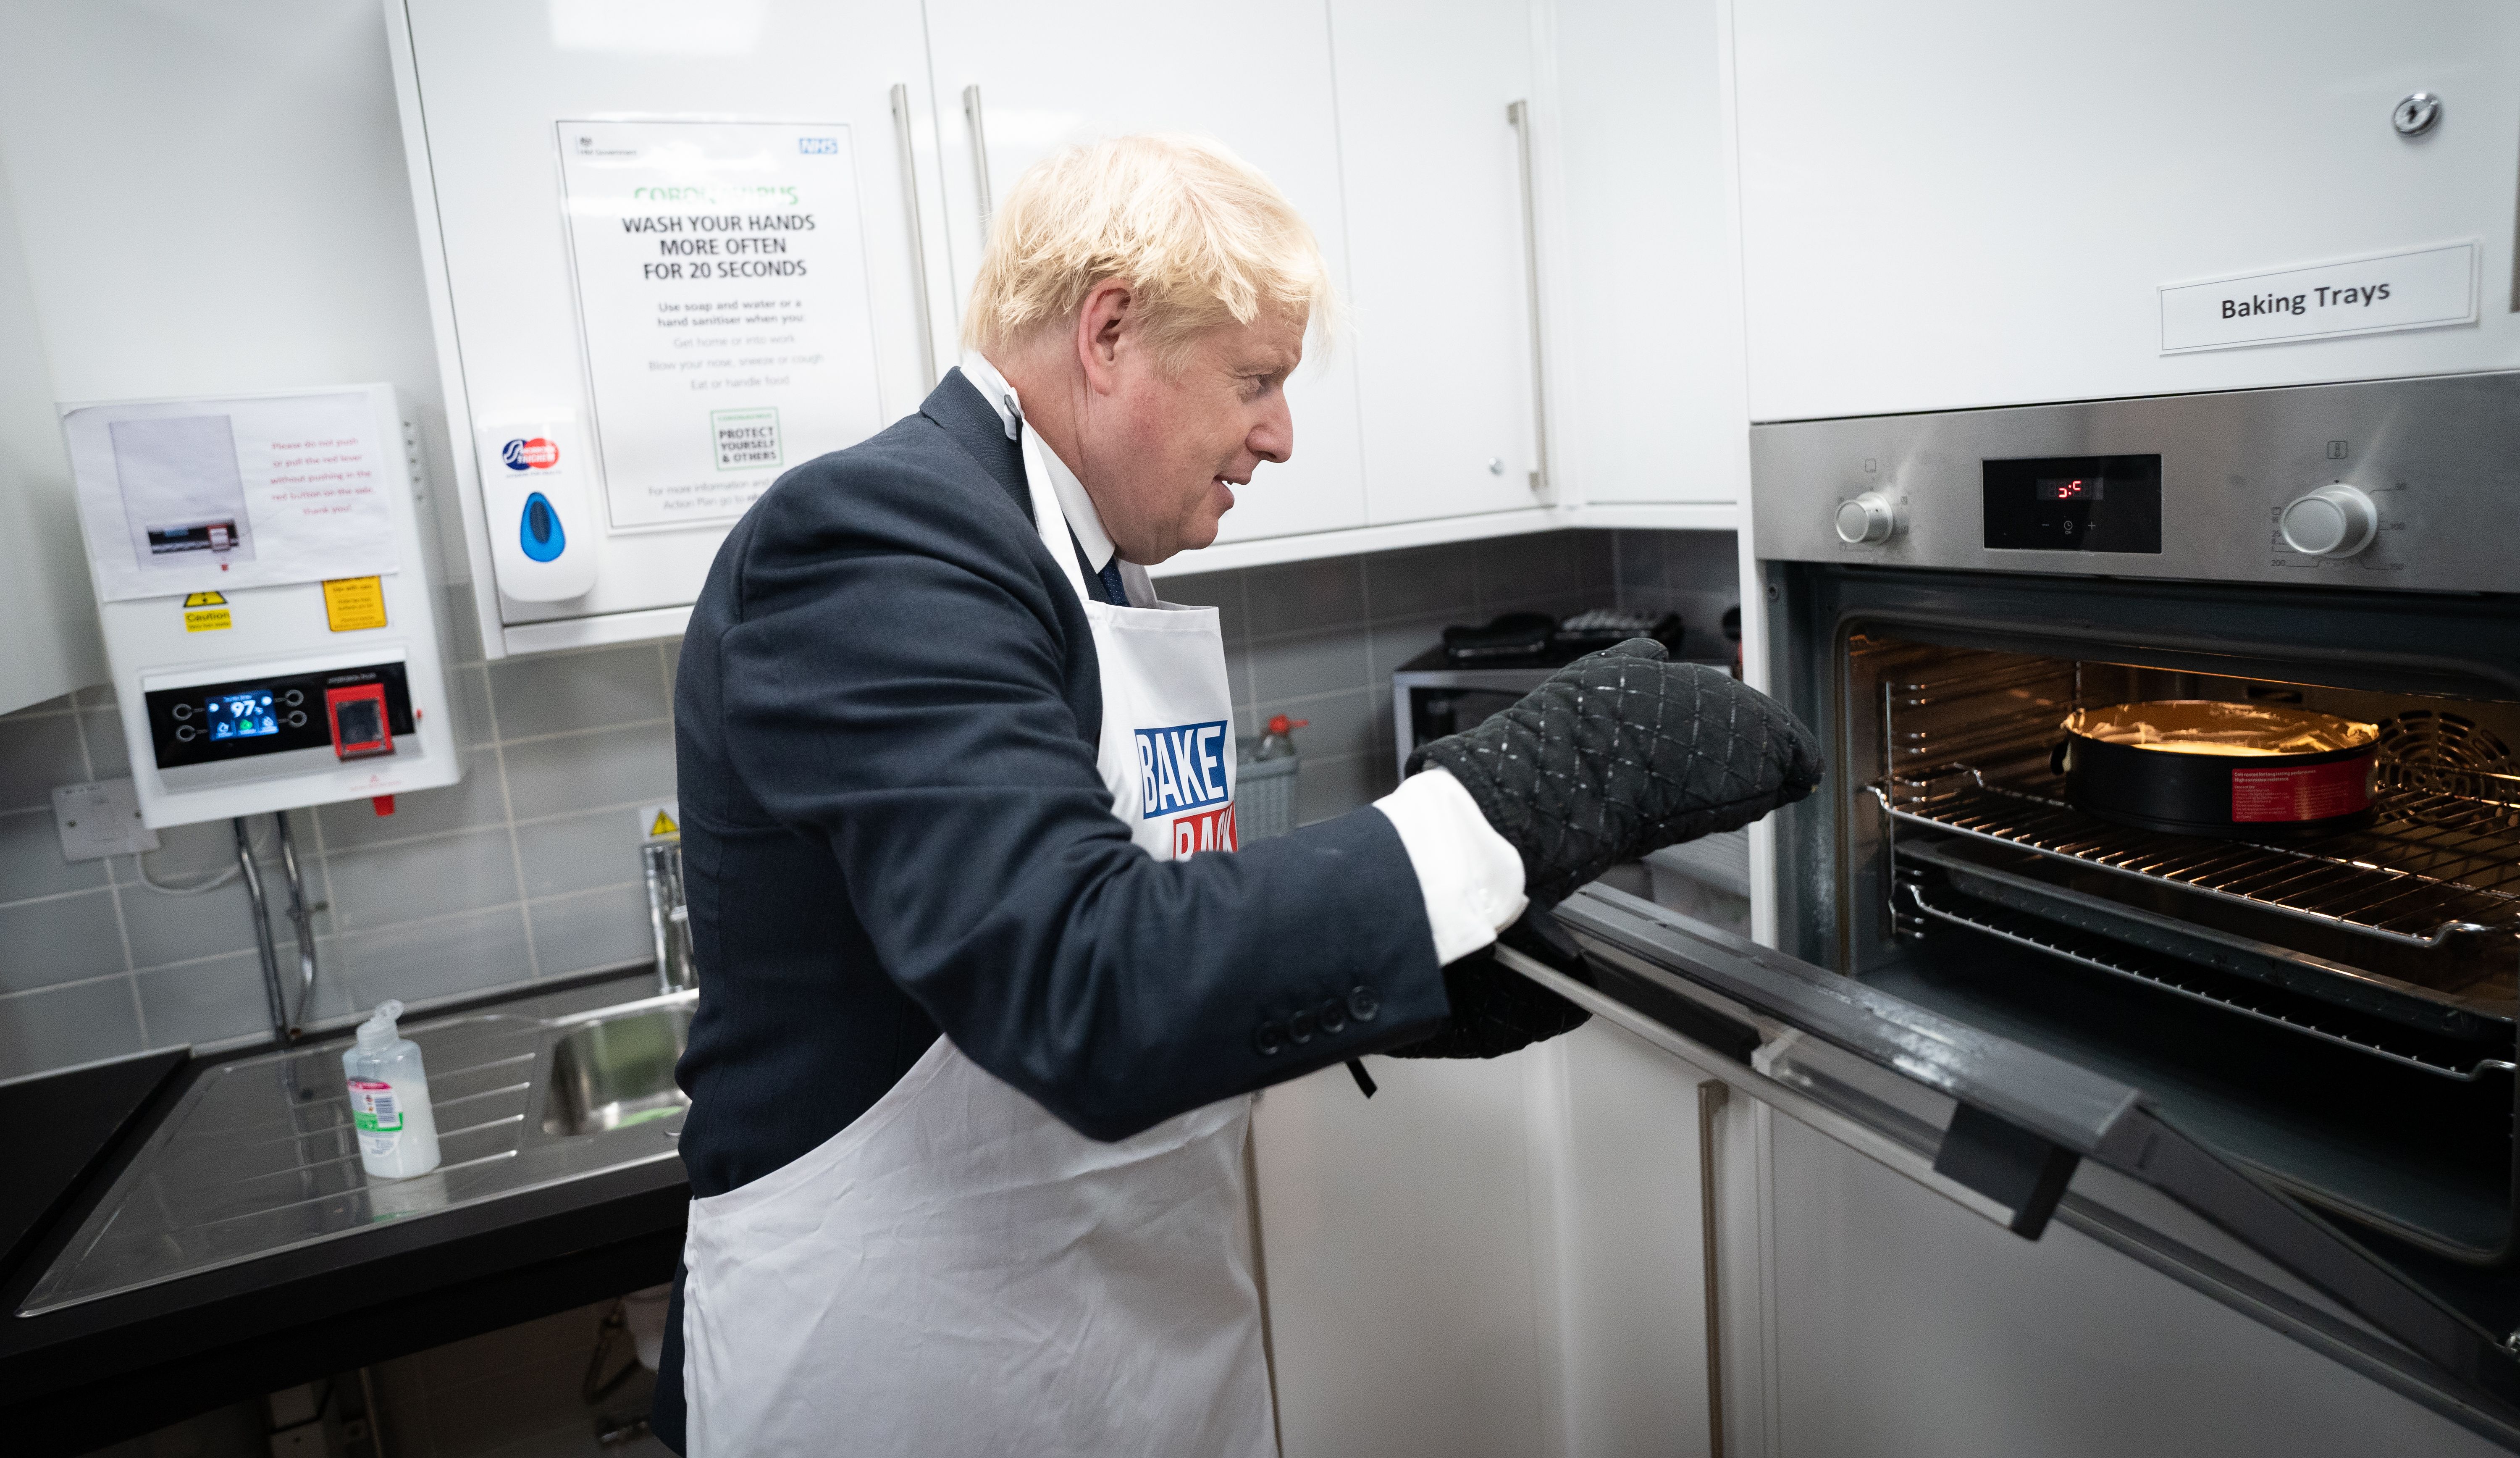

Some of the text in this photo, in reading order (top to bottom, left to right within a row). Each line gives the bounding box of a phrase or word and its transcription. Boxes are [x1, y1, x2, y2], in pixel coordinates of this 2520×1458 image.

[801, 139, 836, 154] NHS
[622, 214, 816, 233] WASH YOUR HANDS
[660, 238, 786, 255] MORE OFTEN
[643, 260, 807, 279] FOR 20 SECONDS
[658, 302, 680, 312] Use
[685, 302, 712, 312] soap
[717, 300, 738, 310] and
[742, 300, 775, 309] water
[2222, 283, 2390, 319] Baking Trays
[658, 317, 688, 328] hand
[692, 315, 740, 326] sanitiser
[745, 313, 777, 323] when
[673, 334, 795, 348] Get home or into work
[648, 360, 676, 371] Blow
[680, 360, 703, 371] your
[739, 357, 774, 366] sneeze
[791, 353, 824, 365] cough
[691, 376, 790, 389] Eat or handle food
[719, 426, 773, 439] PROTECT
[336, 438, 359, 447] push
[722, 439, 774, 451] YOURSELF
[286, 457, 303, 468] pull
[322, 455, 339, 463] red
[734, 452, 777, 462] OTHERS
[270, 475, 305, 484] without
[307, 473, 344, 483] pushing
[667, 485, 691, 494] more
[694, 480, 749, 492] information
[289, 491, 321, 500] button
[186, 612, 231, 622] Caution
[1136, 725, 1224, 814] BAKE
